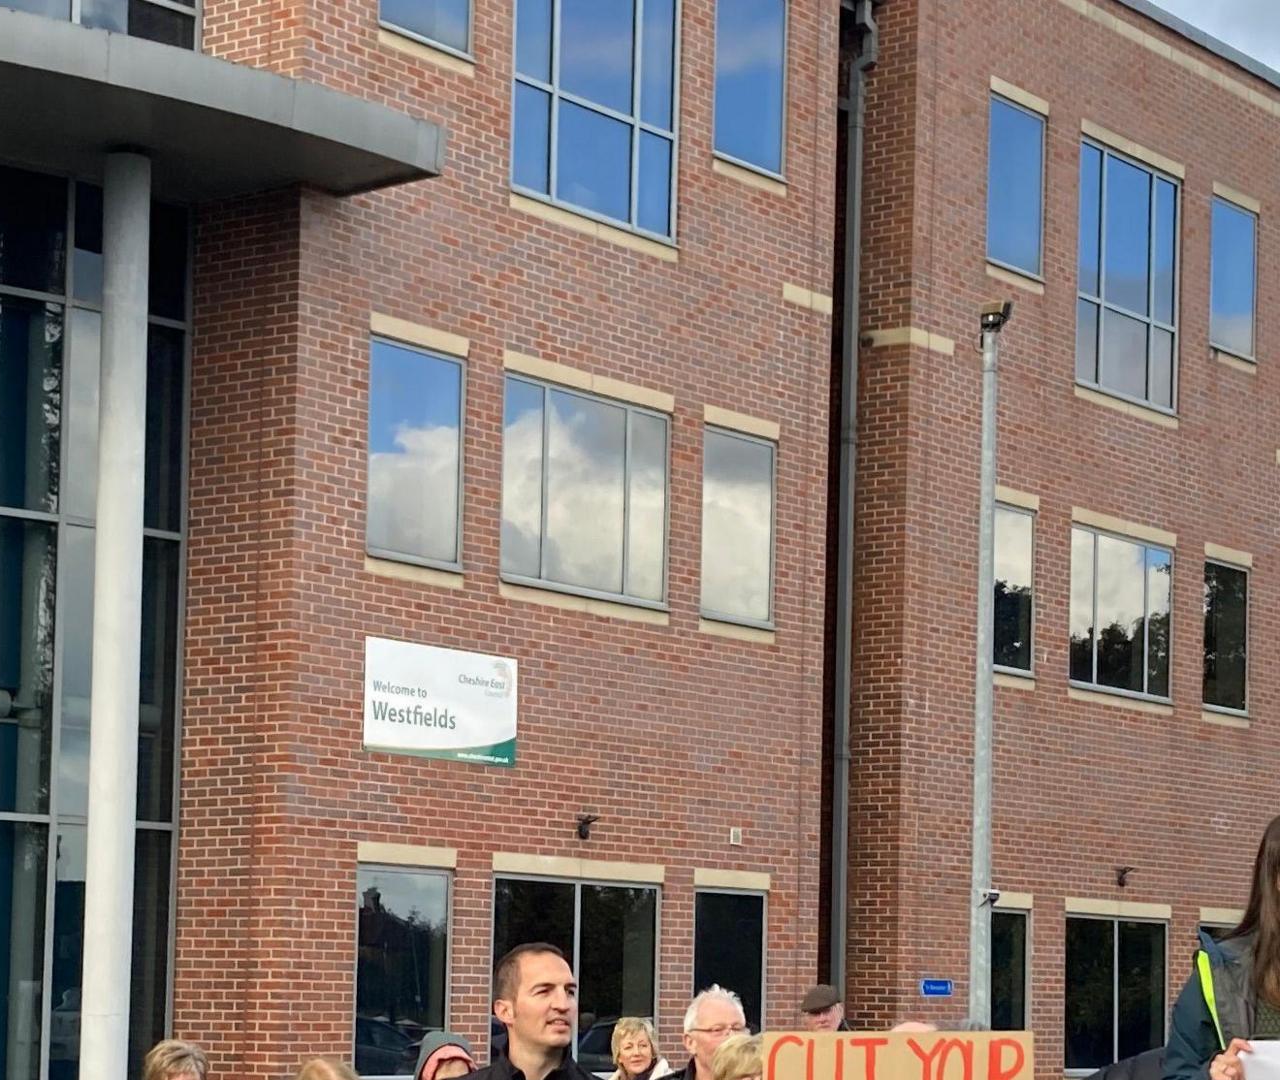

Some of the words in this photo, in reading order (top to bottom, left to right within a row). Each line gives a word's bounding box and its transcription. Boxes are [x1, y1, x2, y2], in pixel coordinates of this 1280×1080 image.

[373, 680, 416, 697] Welcome
[417, 687, 428, 698] to
[372, 700, 456, 730] Westfields
